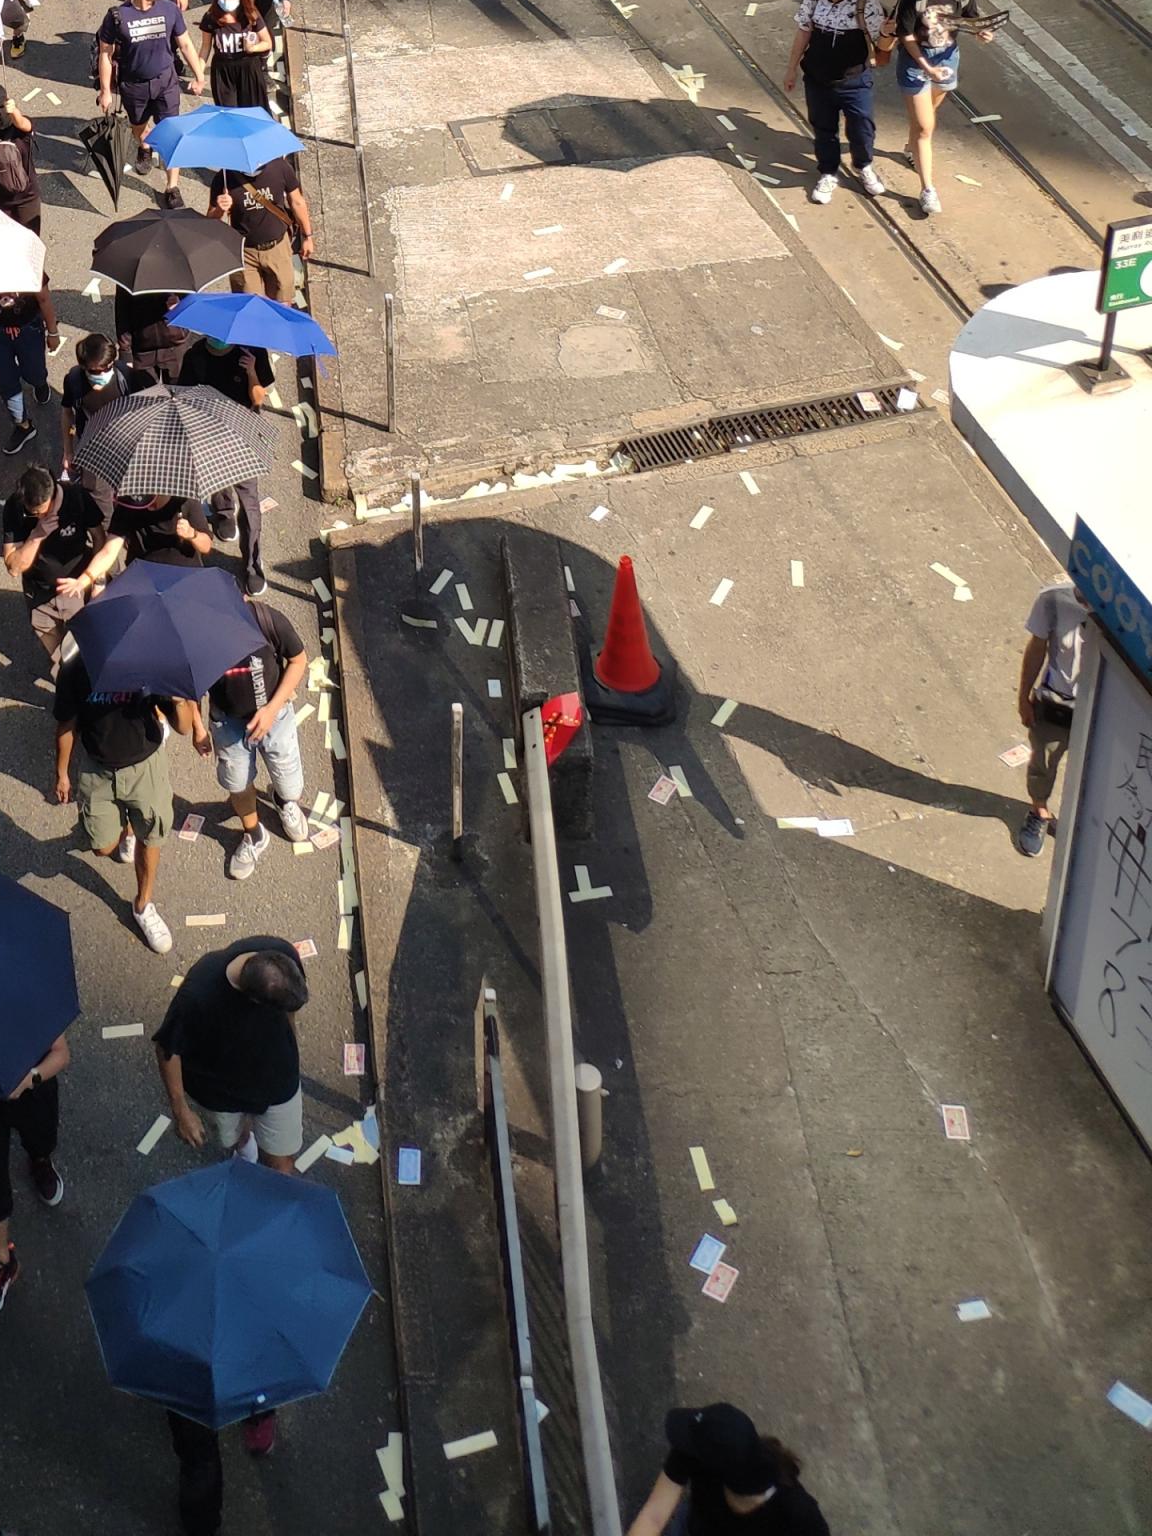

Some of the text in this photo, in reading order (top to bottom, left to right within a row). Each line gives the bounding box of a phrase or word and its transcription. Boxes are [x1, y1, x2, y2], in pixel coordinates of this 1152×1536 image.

[127, 16, 166, 29] UNDER
[131, 32, 167, 44] ARMOUR
[215, 31, 249, 53] AME
[1114, 258, 1138, 269] 33E
